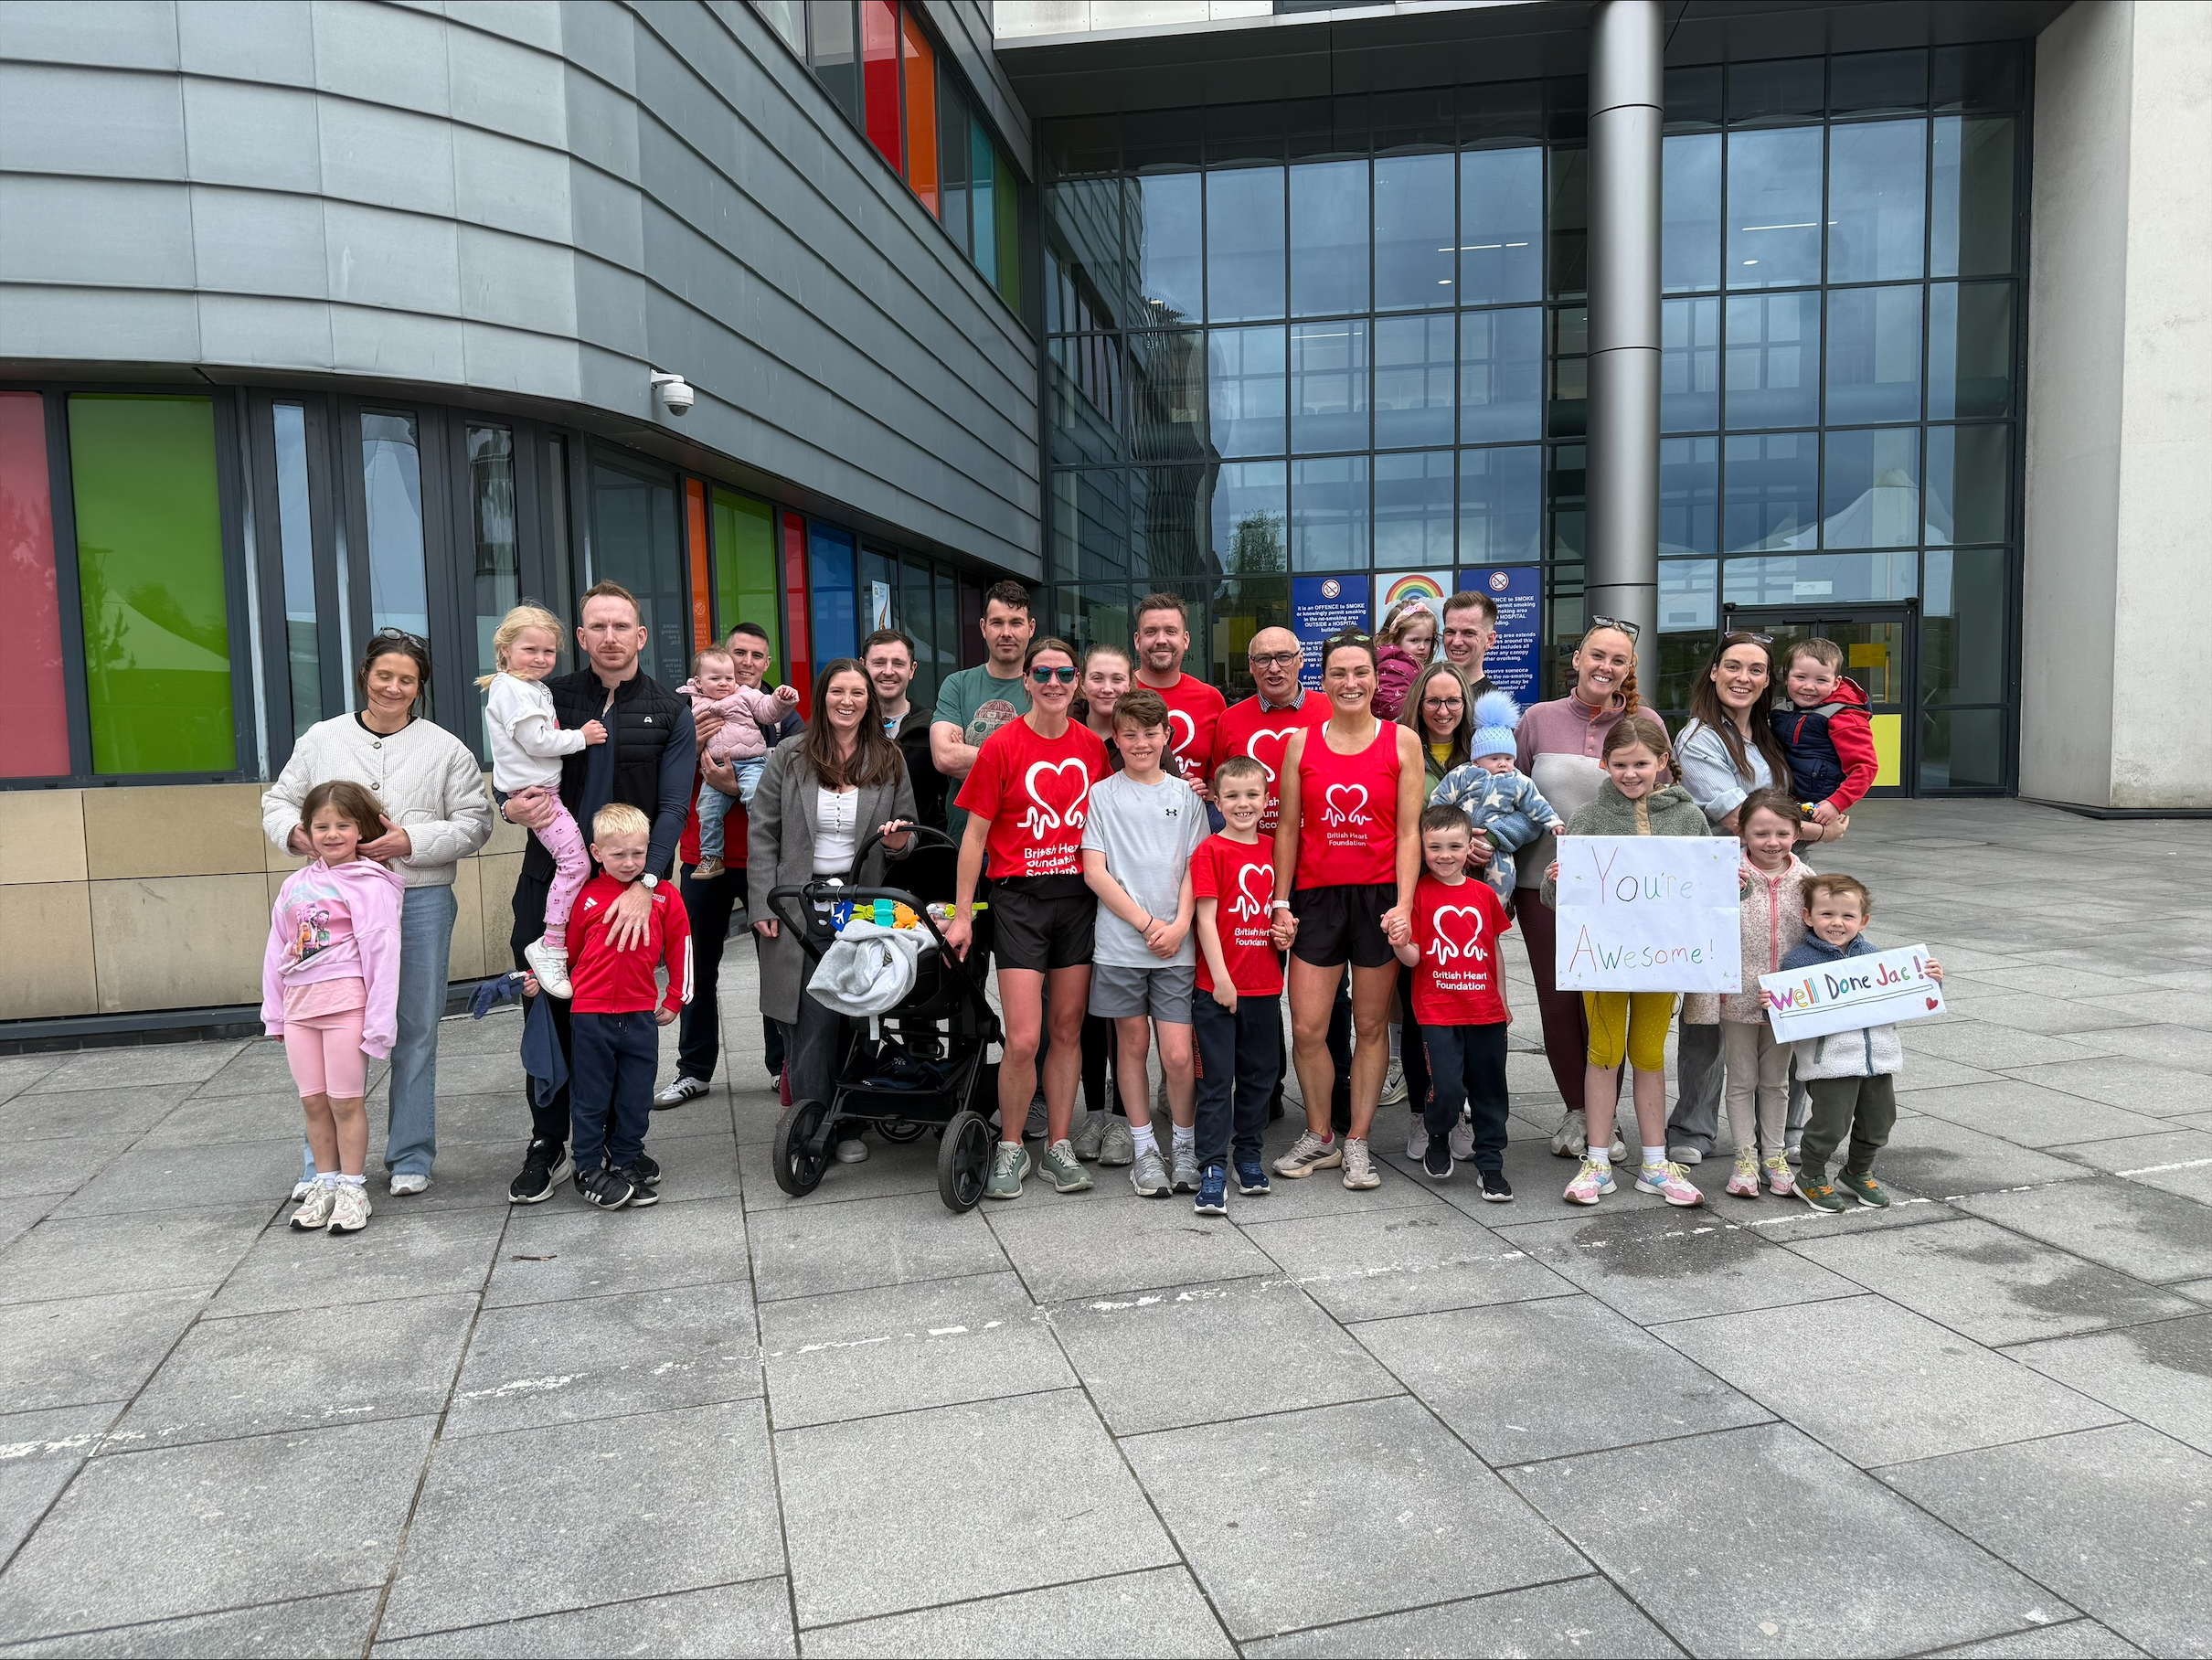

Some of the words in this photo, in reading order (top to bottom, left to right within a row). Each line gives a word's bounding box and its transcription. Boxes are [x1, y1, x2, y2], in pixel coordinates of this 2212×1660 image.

[1591, 845, 1693, 904] You're
[1234, 928, 1258, 936] British
[1569, 924, 1714, 973] Awesome!
[1432, 970, 1462, 980] British
[1463, 971, 1487, 980] Heart
[1436, 980, 1486, 990] Foundation
[1767, 977, 1820, 1011] Well
[1824, 974, 1872, 1000] Done
